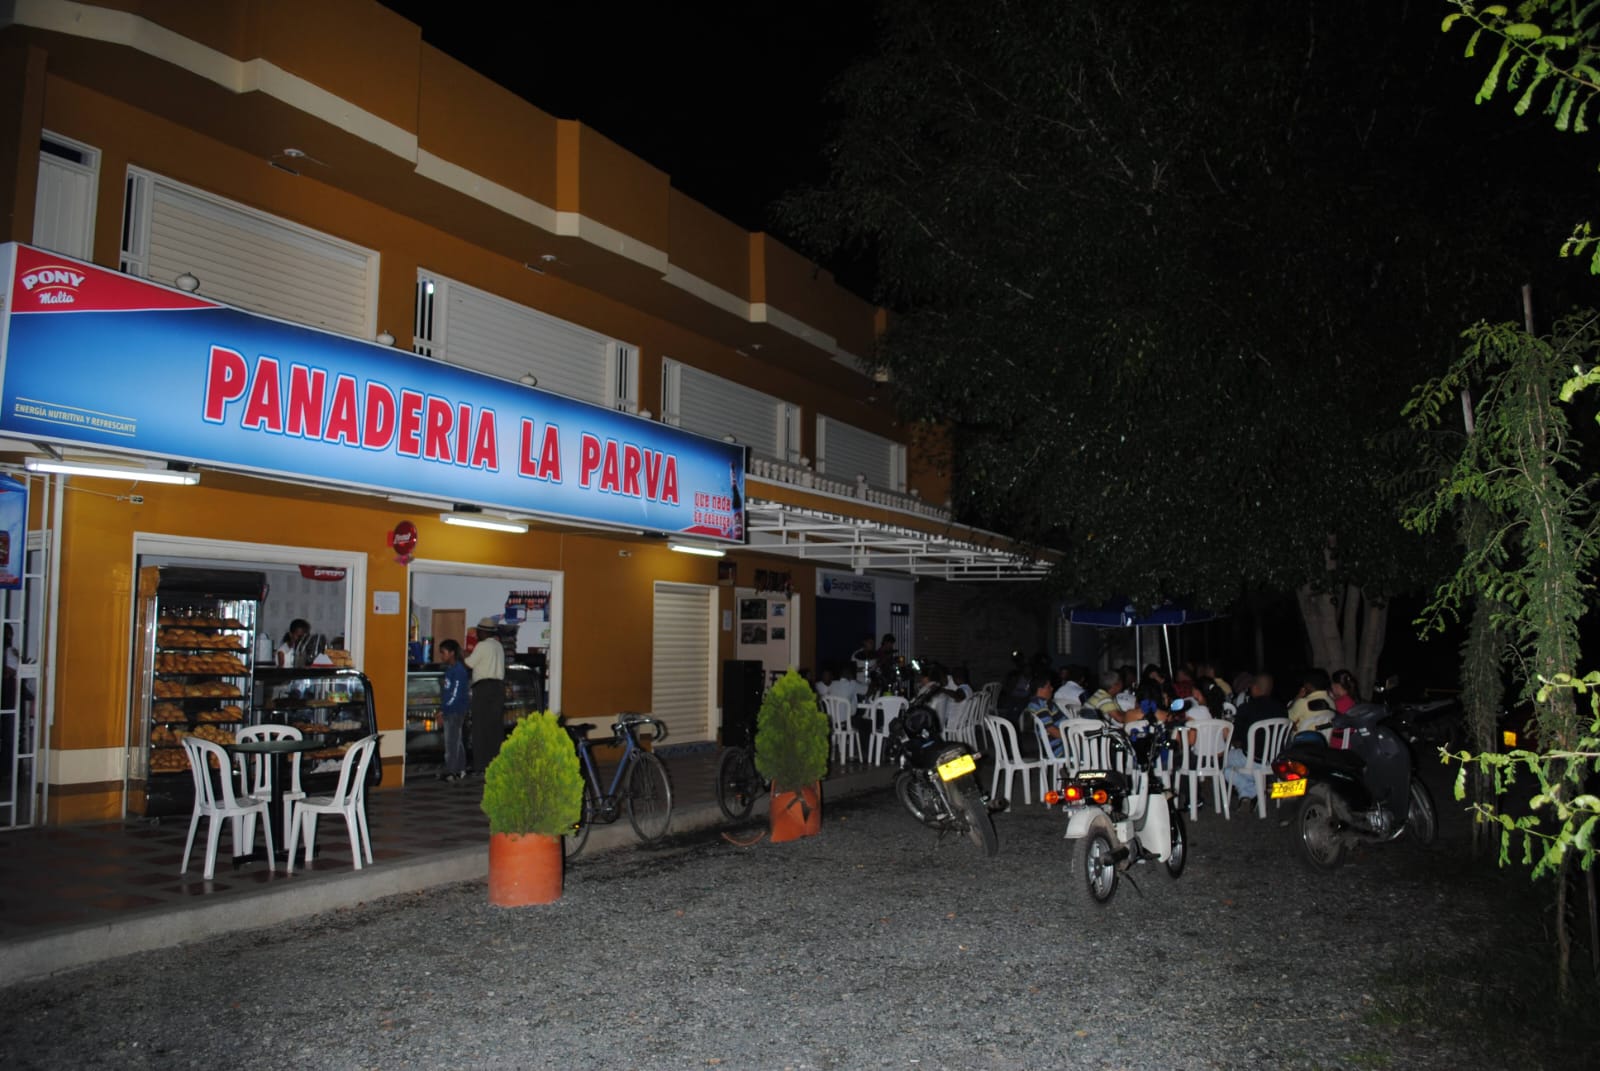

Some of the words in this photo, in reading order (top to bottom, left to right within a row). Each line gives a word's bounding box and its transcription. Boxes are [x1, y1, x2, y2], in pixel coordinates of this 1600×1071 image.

[22, 270, 85, 290] PONY
[48, 410, 85, 423] NUTRITIVA
[85, 416, 91, 425] Y
[91, 417, 137, 433] REFRESCANTE
[203, 344, 499, 472] PANADERIA
[518, 417, 562, 483] LA
[579, 432, 680, 505] PARVA
